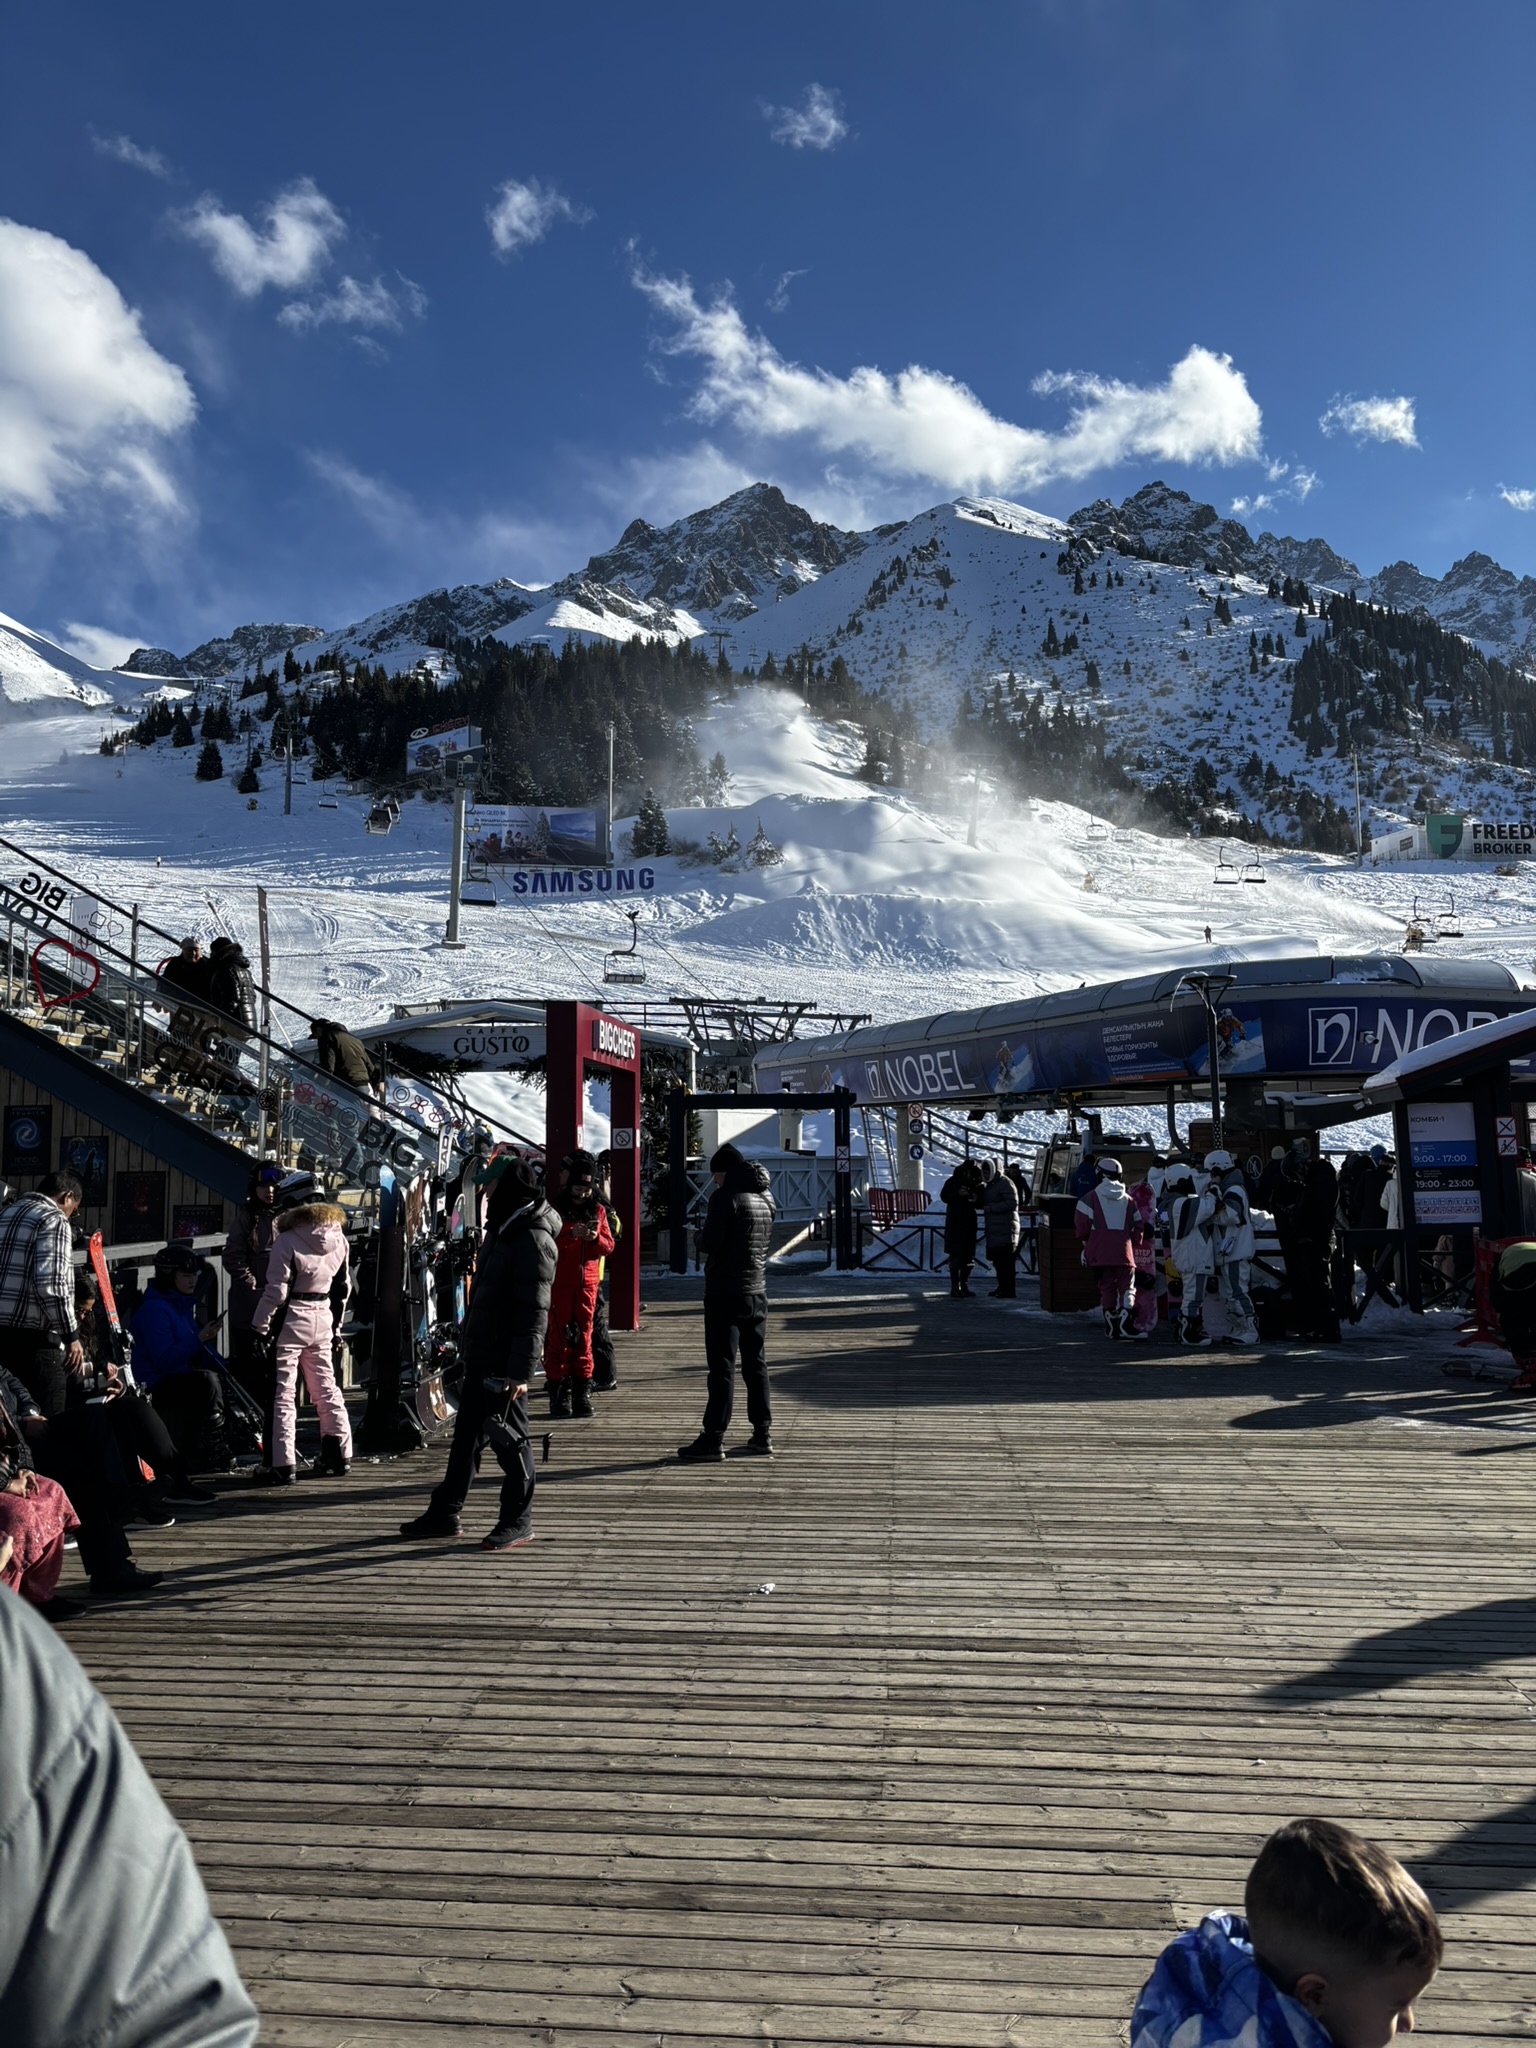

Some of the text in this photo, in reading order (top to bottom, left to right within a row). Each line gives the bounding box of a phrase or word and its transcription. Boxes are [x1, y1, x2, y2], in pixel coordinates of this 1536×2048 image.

[1472, 823, 1536, 840] FREED
[1473, 843, 1532, 855] BROKER
[512, 867, 656, 895] SAMSUNG
[466, 1027, 518, 1035] CAFFE
[598, 1019, 636, 1060] BIGCHEFS
[453, 1035, 530, 1055] GUSTO
[1125, 1041, 1159, 1052] ГОРИЗОНТЫ
[885, 1050, 976, 1097] NOBEL
[358, 1119, 420, 1167] BIG
[440, 1135, 450, 1178] EAD
[1413, 1155, 1435, 1163] 9:00
[1442, 1154, 1467, 1162] 17:00
[1415, 1180, 1440, 1188] 19:00
[1448, 1179, 1474, 1187] 23:00
